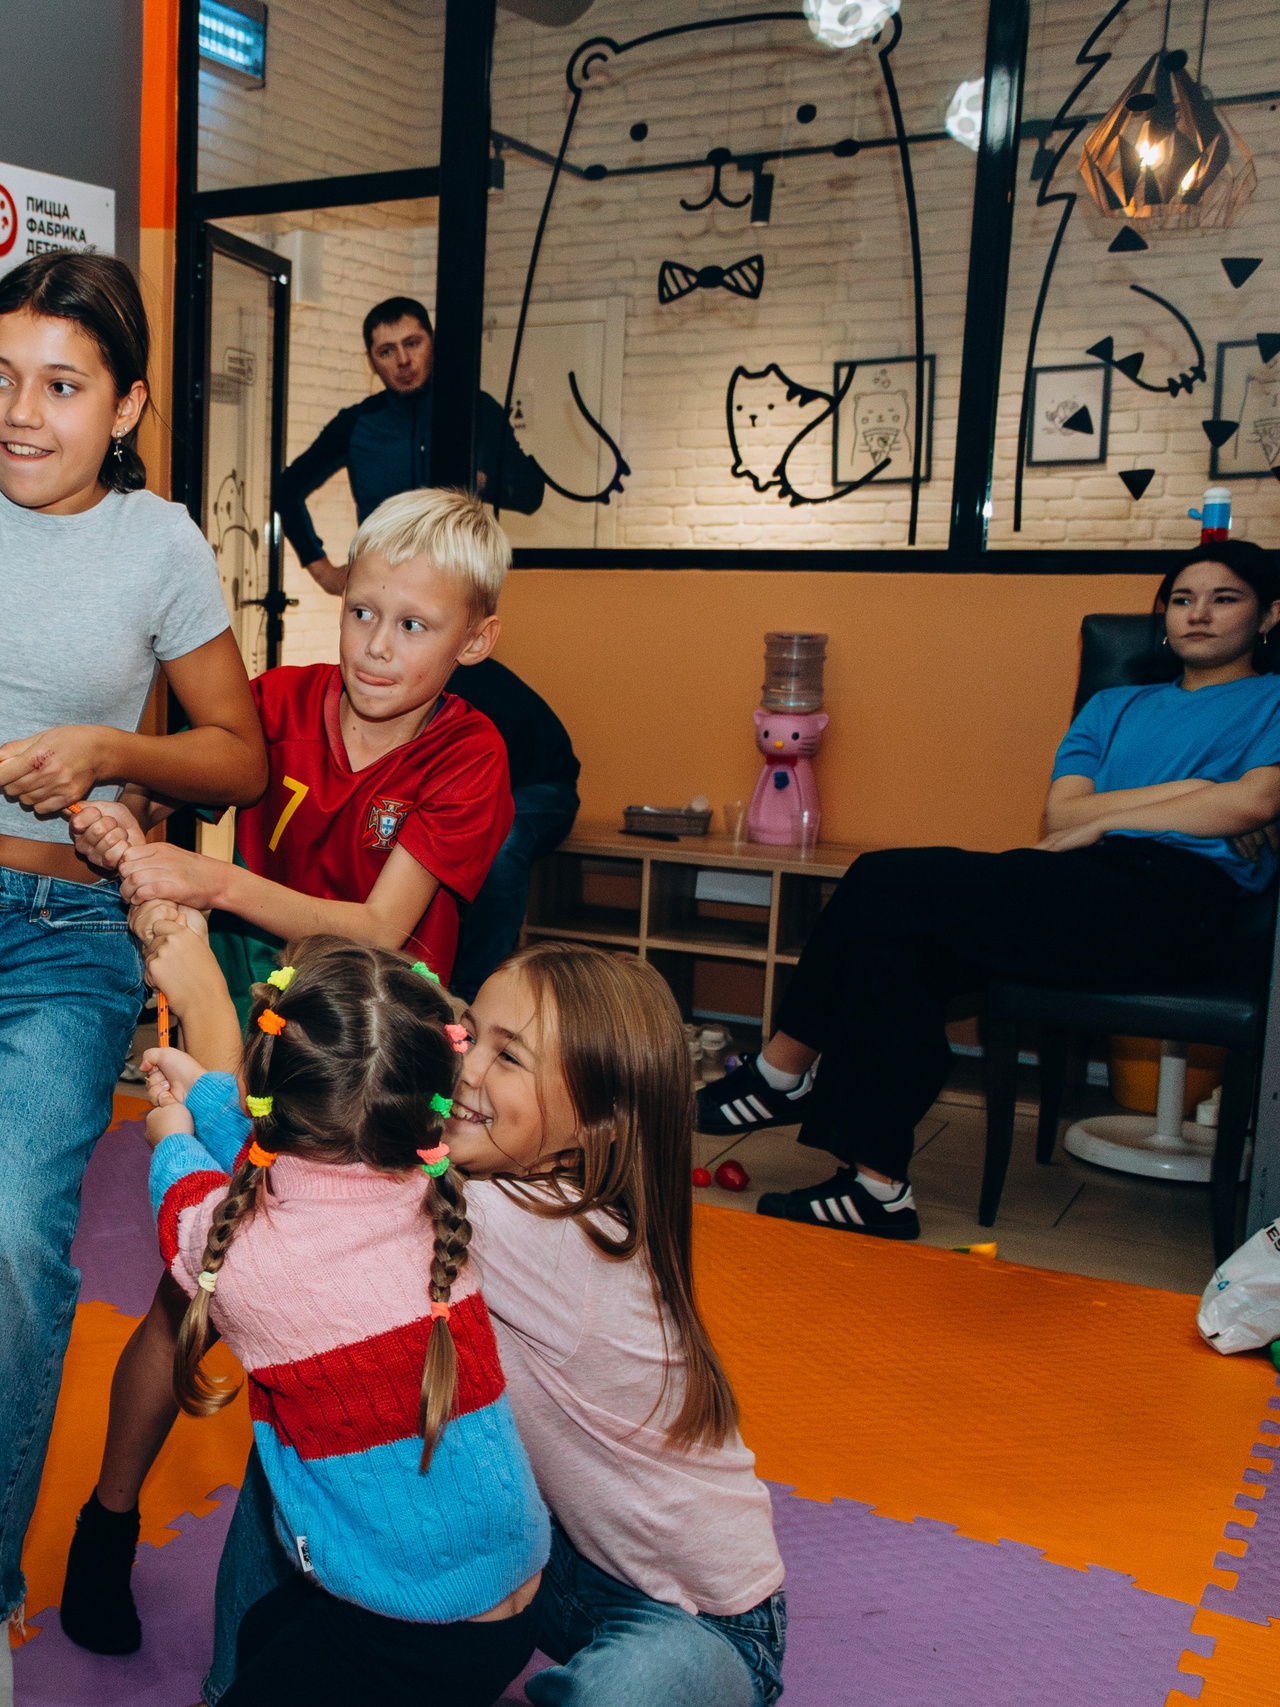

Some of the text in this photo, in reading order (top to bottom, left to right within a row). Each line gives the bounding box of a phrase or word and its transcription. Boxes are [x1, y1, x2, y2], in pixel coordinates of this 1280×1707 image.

[26, 196, 70, 220] ПИЦЦА
[26, 217, 87, 243] ФАБРИКА
[268, 775, 309, 852] 7
